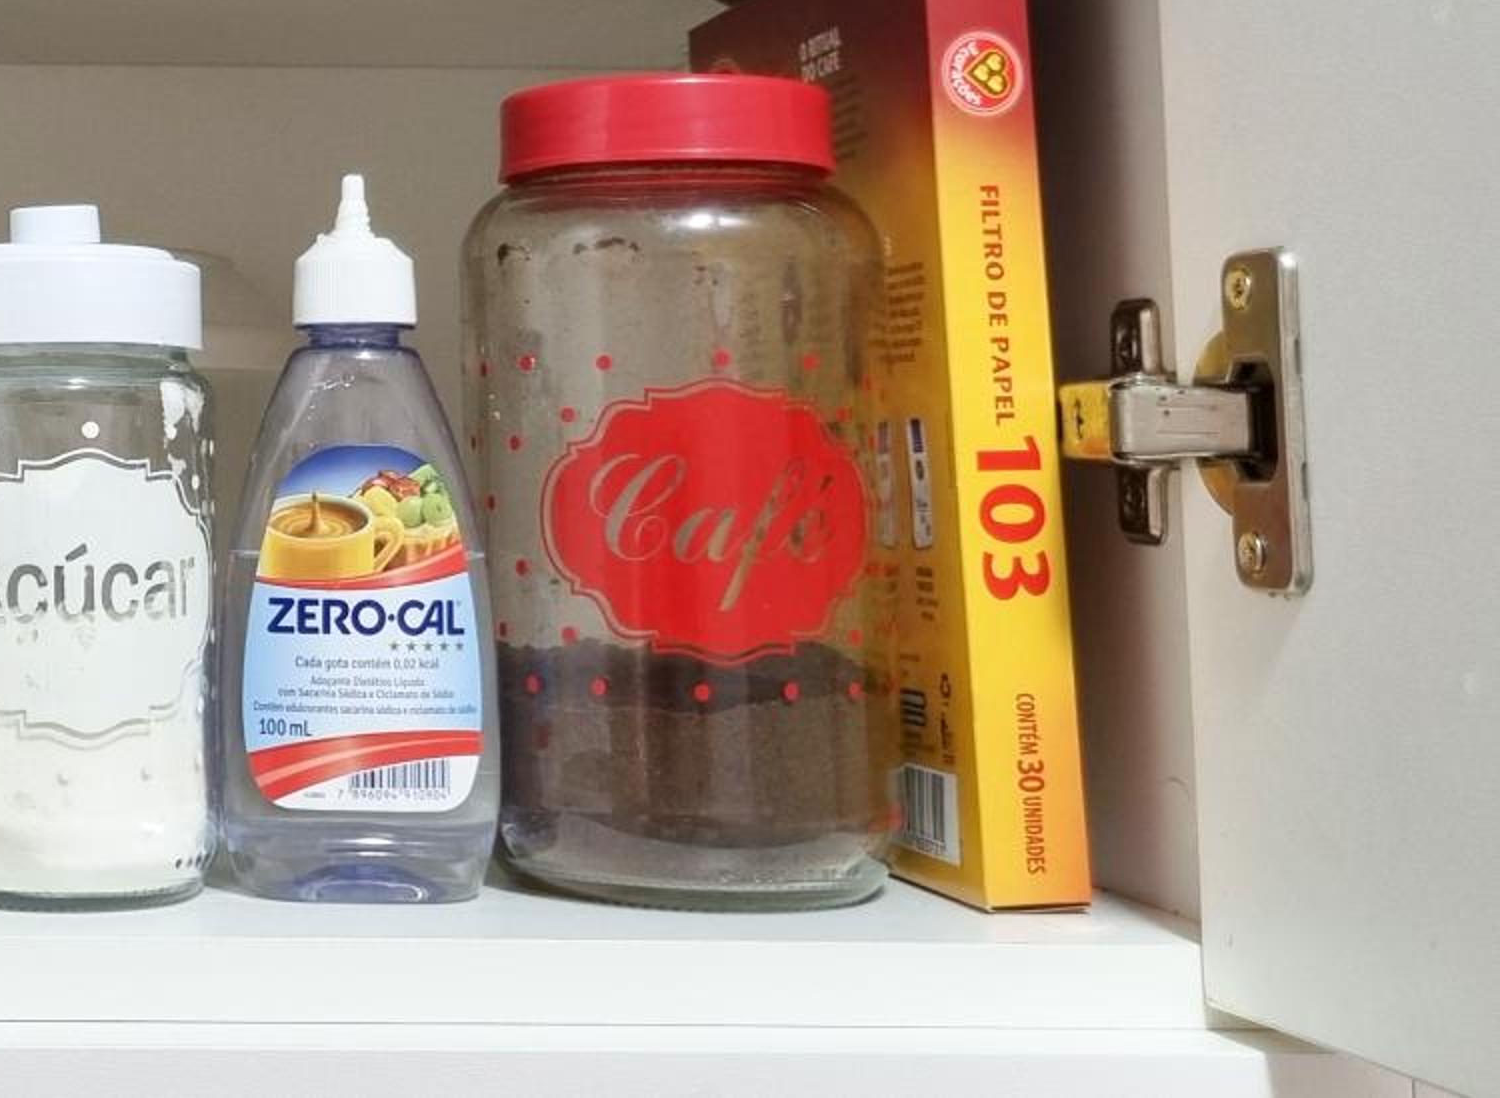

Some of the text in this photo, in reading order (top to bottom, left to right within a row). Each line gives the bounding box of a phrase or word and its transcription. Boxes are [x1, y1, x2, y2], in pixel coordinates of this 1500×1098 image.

[980, 184, 1016, 427] FILTRO DE PAPEL
[588, 453, 836, 613] Café
[976, 434, 1052, 602] 103
[259, 717, 312, 736] 100 mL
[295, 656, 440, 672] Cada gota contém 0,02 kcal
[1015, 692, 1048, 876] CONTÉM 30 UNIDADES
